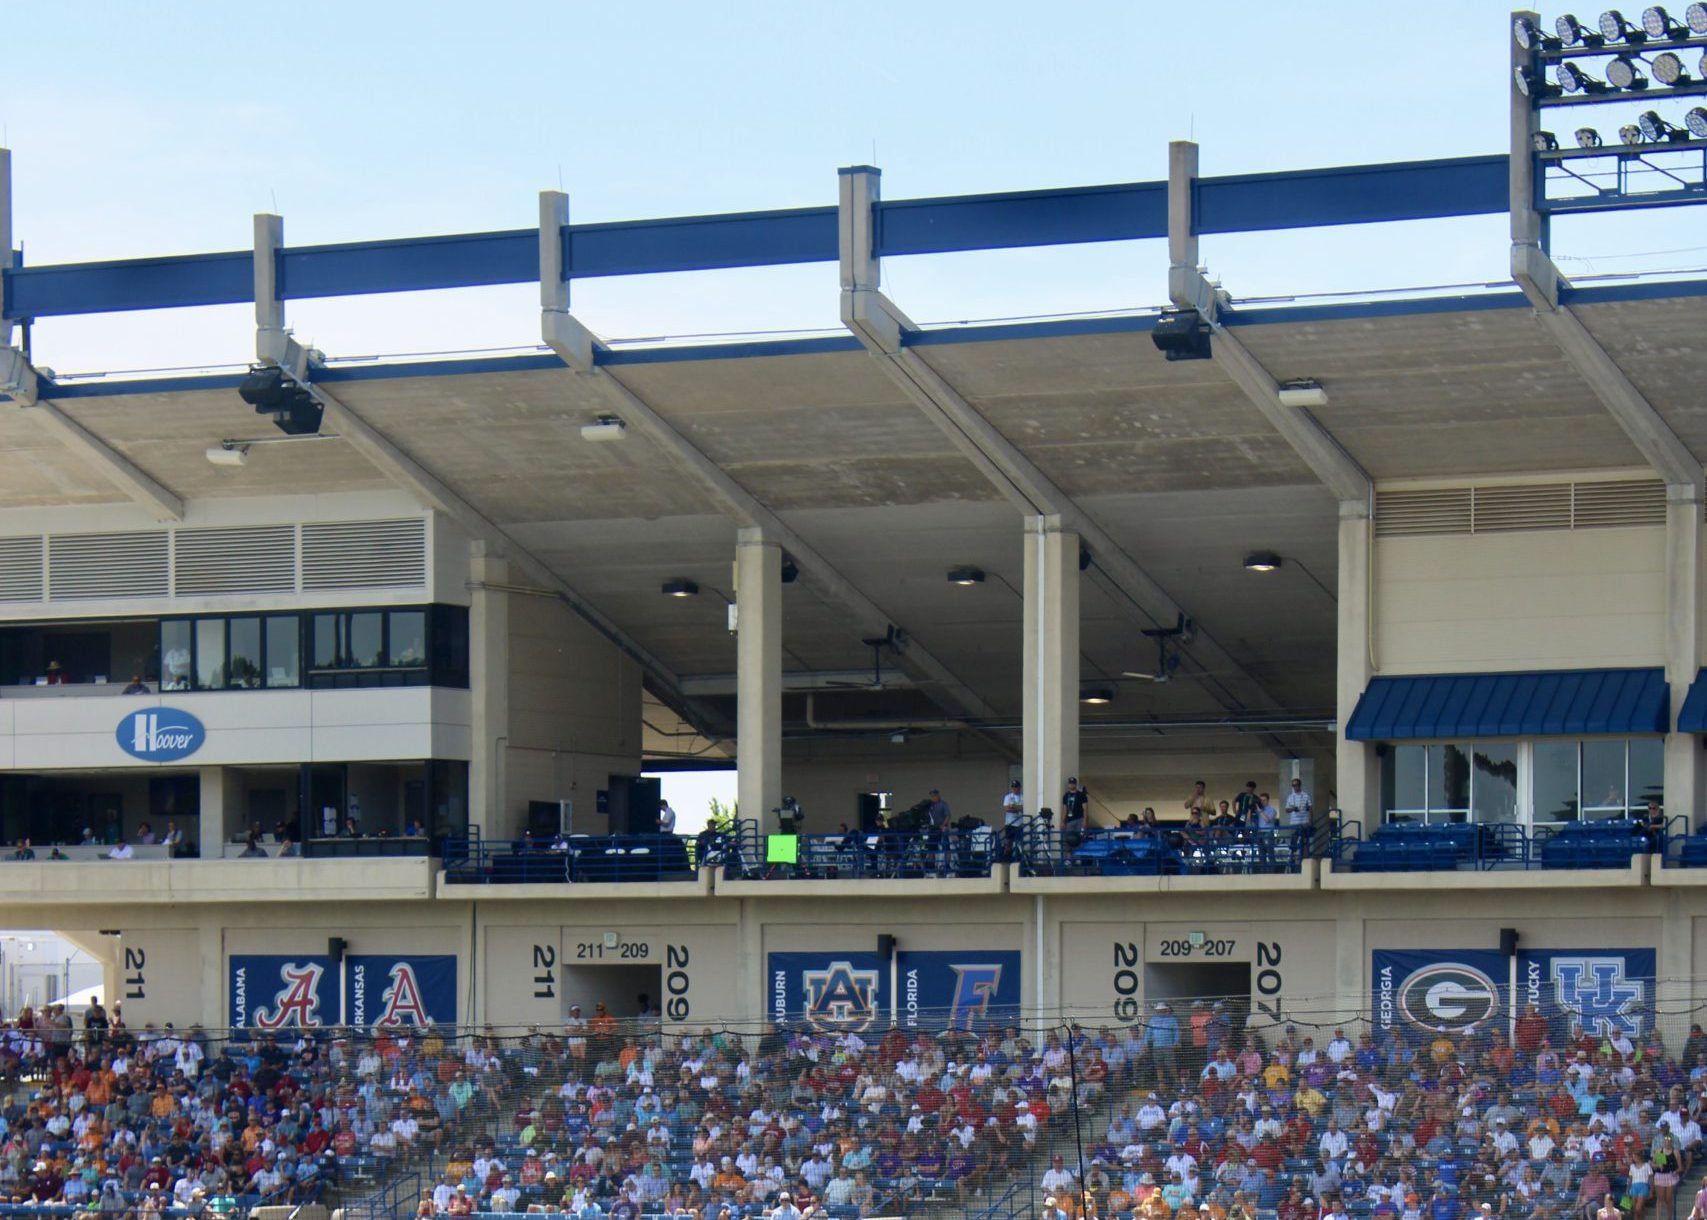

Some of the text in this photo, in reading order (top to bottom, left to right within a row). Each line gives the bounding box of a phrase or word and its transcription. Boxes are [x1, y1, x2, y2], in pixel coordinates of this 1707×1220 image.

[131, 714, 193, 752] Hoover
[125, 947, 145, 998] 211
[533, 944, 555, 998] 211
[577, 943, 649, 959] 211 209
[1160, 940, 1236, 956] 209 207
[236, 967, 246, 1029] ALABAMA
[667, 944, 690, 1021] 209
[907, 969, 918, 1027] FLORIDA
[1114, 942, 1138, 1023] 209
[1257, 941, 1282, 1022] 207
